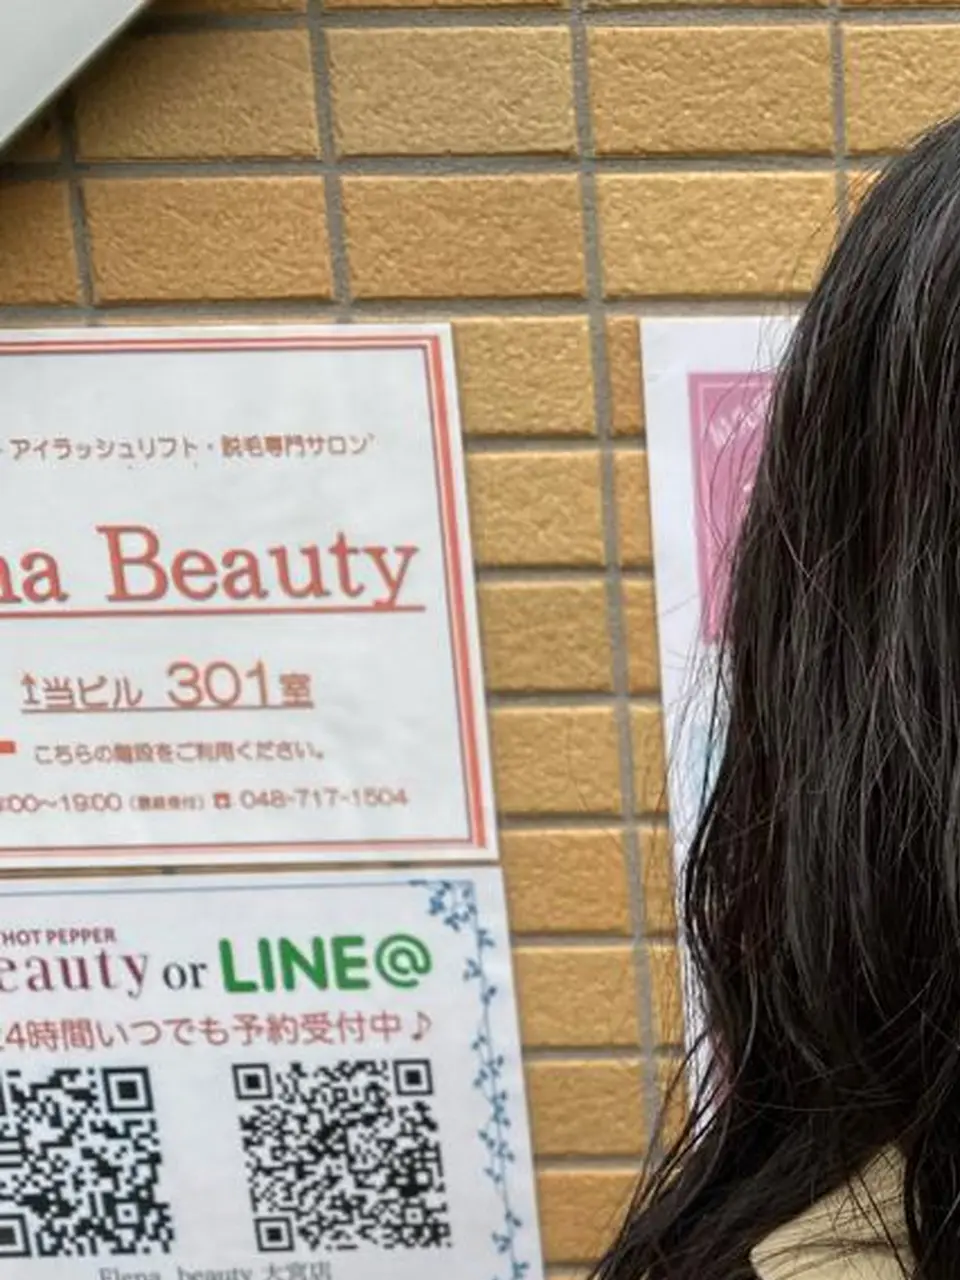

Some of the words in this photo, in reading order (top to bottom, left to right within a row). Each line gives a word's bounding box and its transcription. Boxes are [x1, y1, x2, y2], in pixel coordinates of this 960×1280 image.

[95, 523, 420, 611] Beauty
[43, 675, 143, 709] 当ビル
[166, 659, 314, 707] 301室
[239, 788, 409, 810] 048-717-1504
[1, 929, 42, 947] HOT
[46, 927, 117, 946] PEPPER
[162, 961, 208, 990] or
[219, 933, 433, 993] LINE@
[0, 1010, 402, 1053] 4時間いつでも予約受付中
